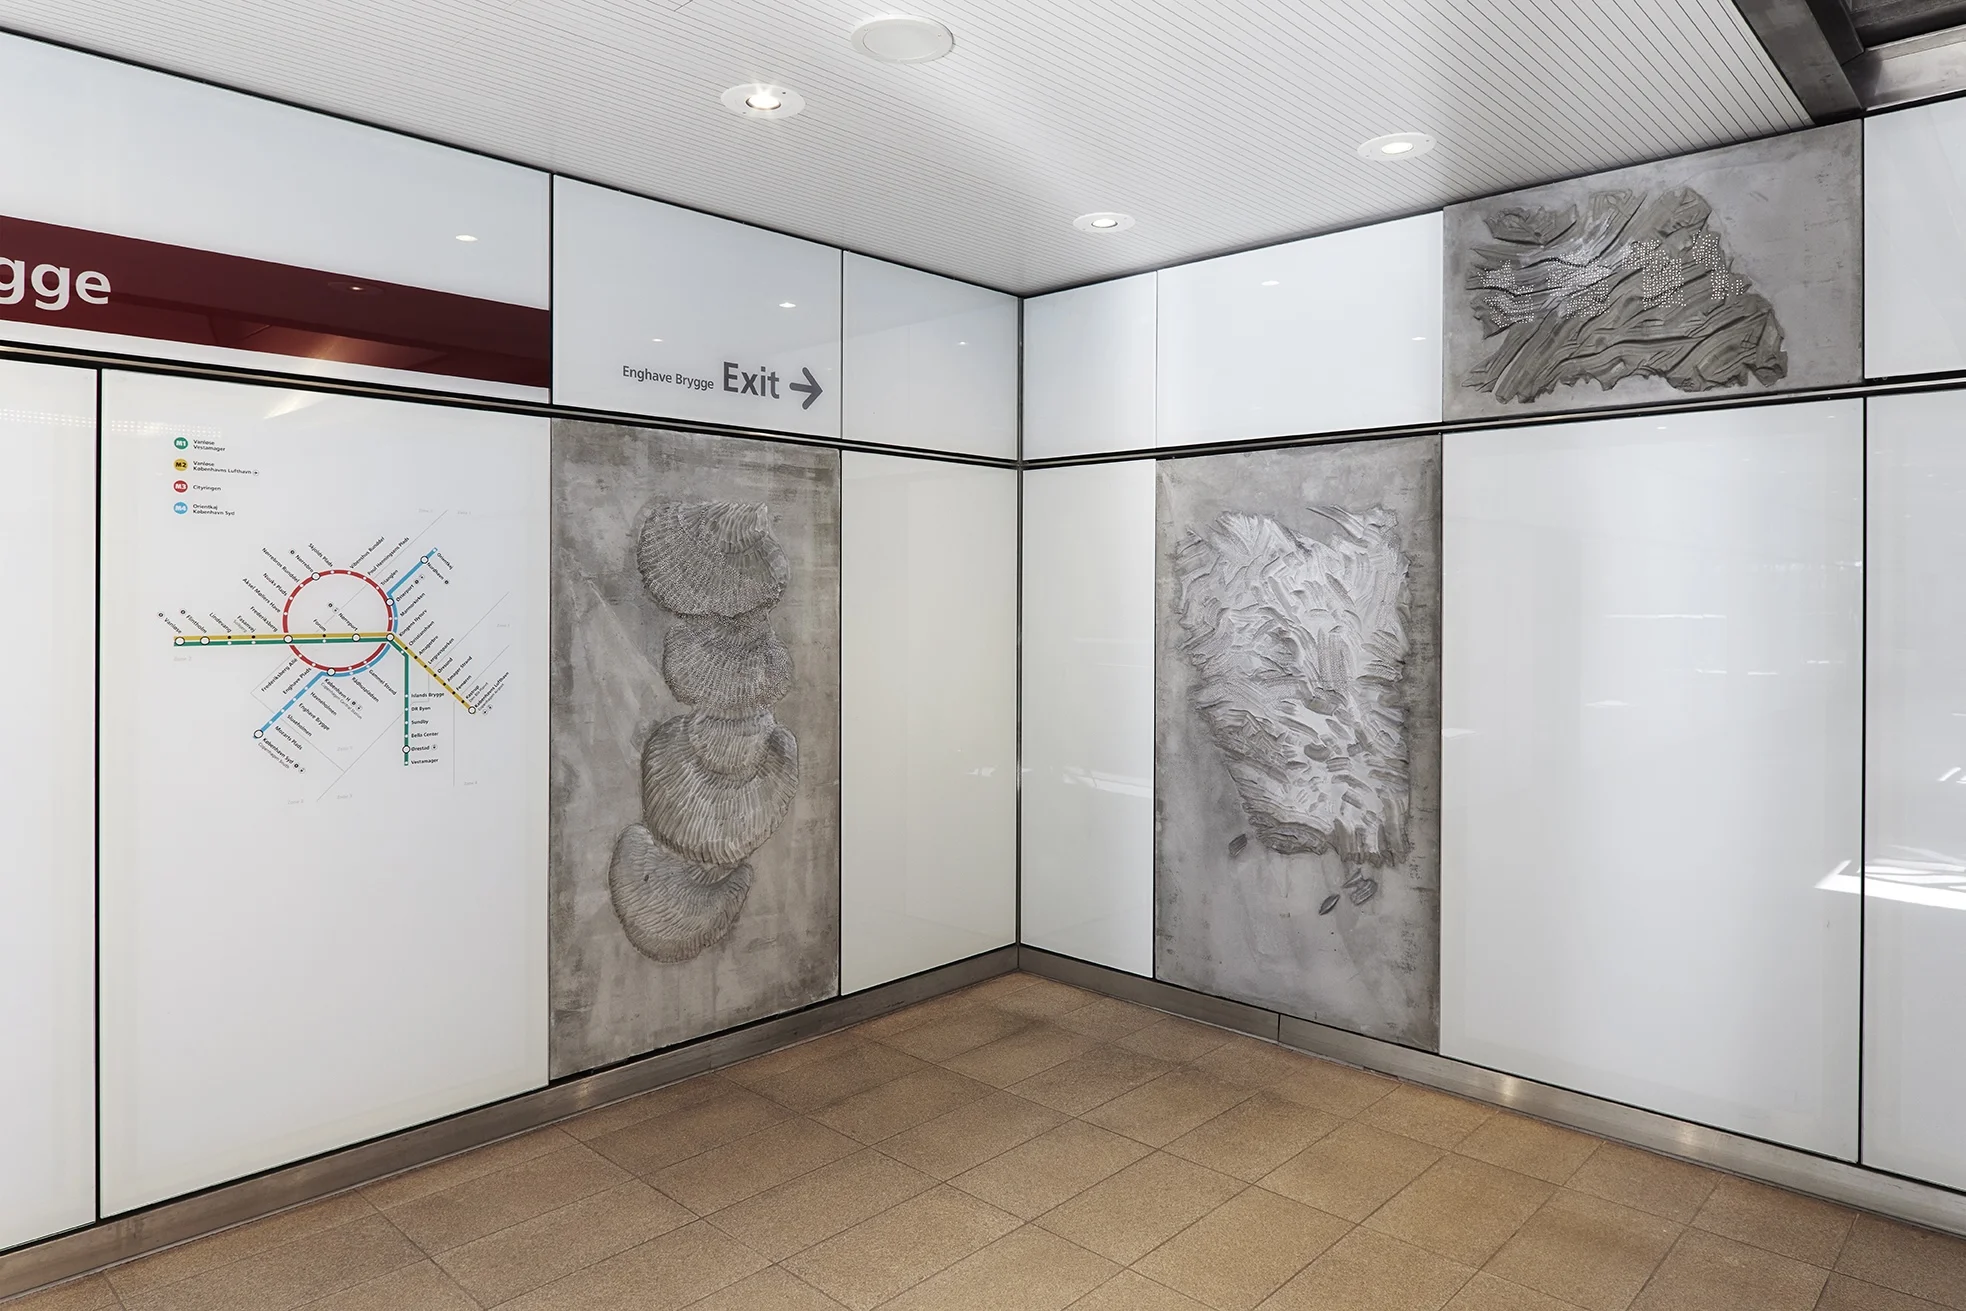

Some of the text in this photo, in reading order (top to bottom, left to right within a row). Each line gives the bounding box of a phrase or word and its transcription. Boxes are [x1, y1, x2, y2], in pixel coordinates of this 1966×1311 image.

[0, 256, 111, 310] gge
[622, 362, 780, 399] Enghave Brygge Exit
